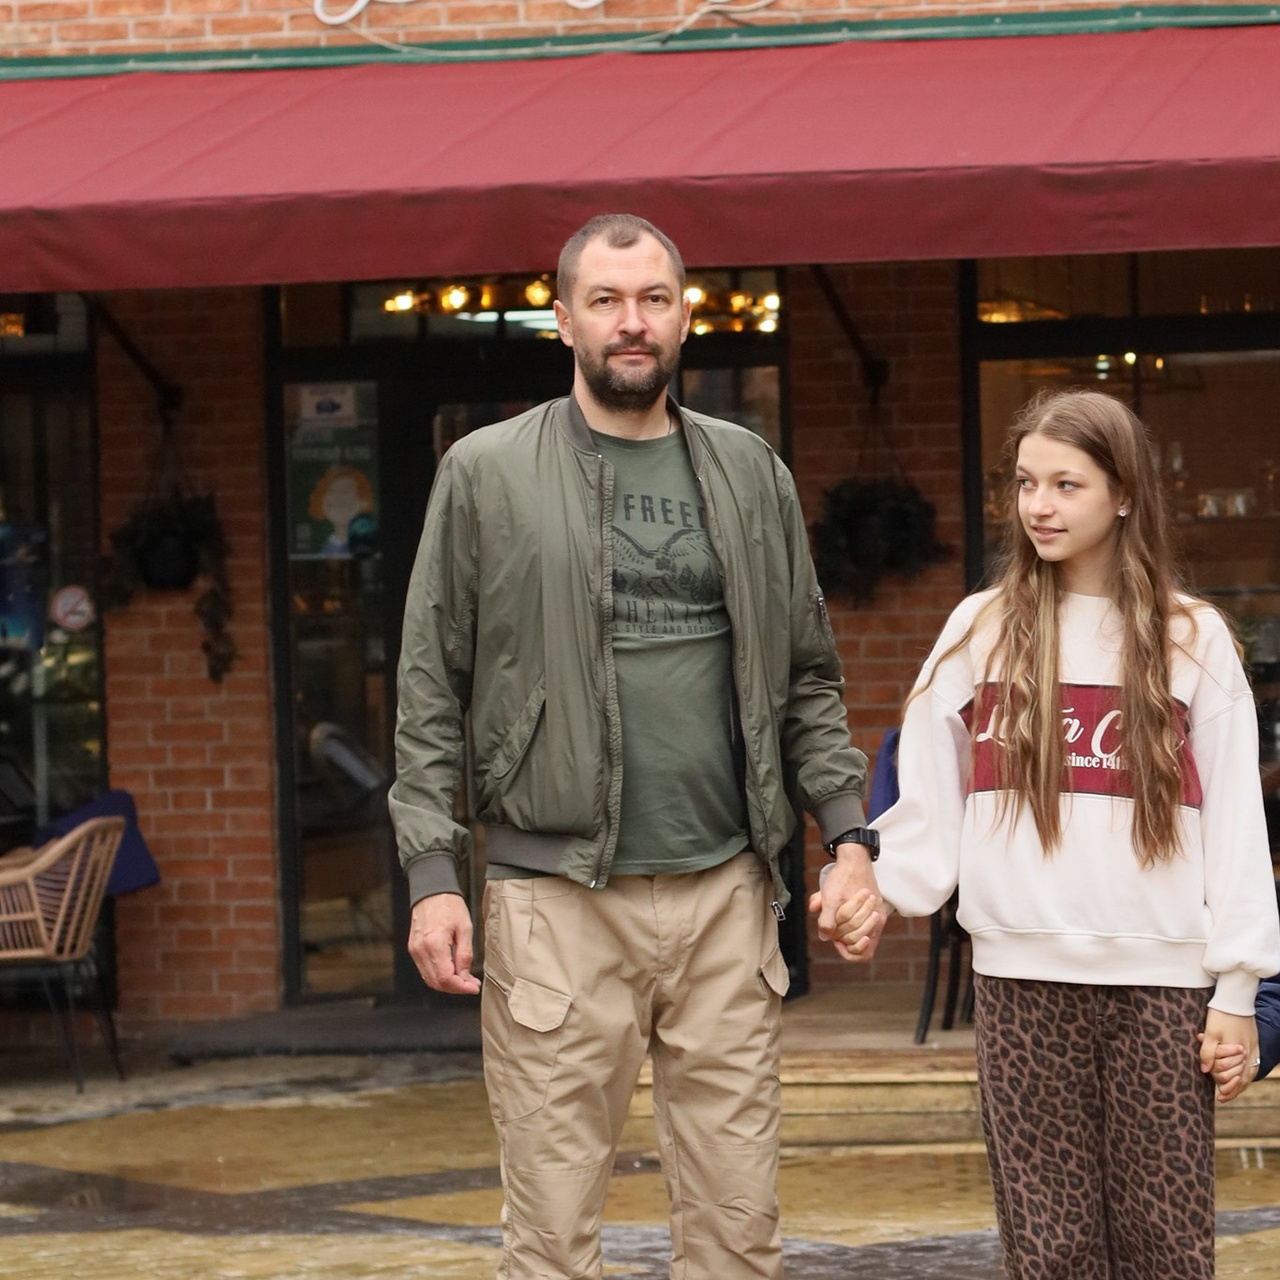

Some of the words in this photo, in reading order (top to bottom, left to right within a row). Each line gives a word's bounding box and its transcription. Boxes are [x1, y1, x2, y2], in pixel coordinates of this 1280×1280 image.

[625, 623, 656, 634] STYLE
[662, 624, 682, 634] AND
[1064, 752, 1100, 768] since
